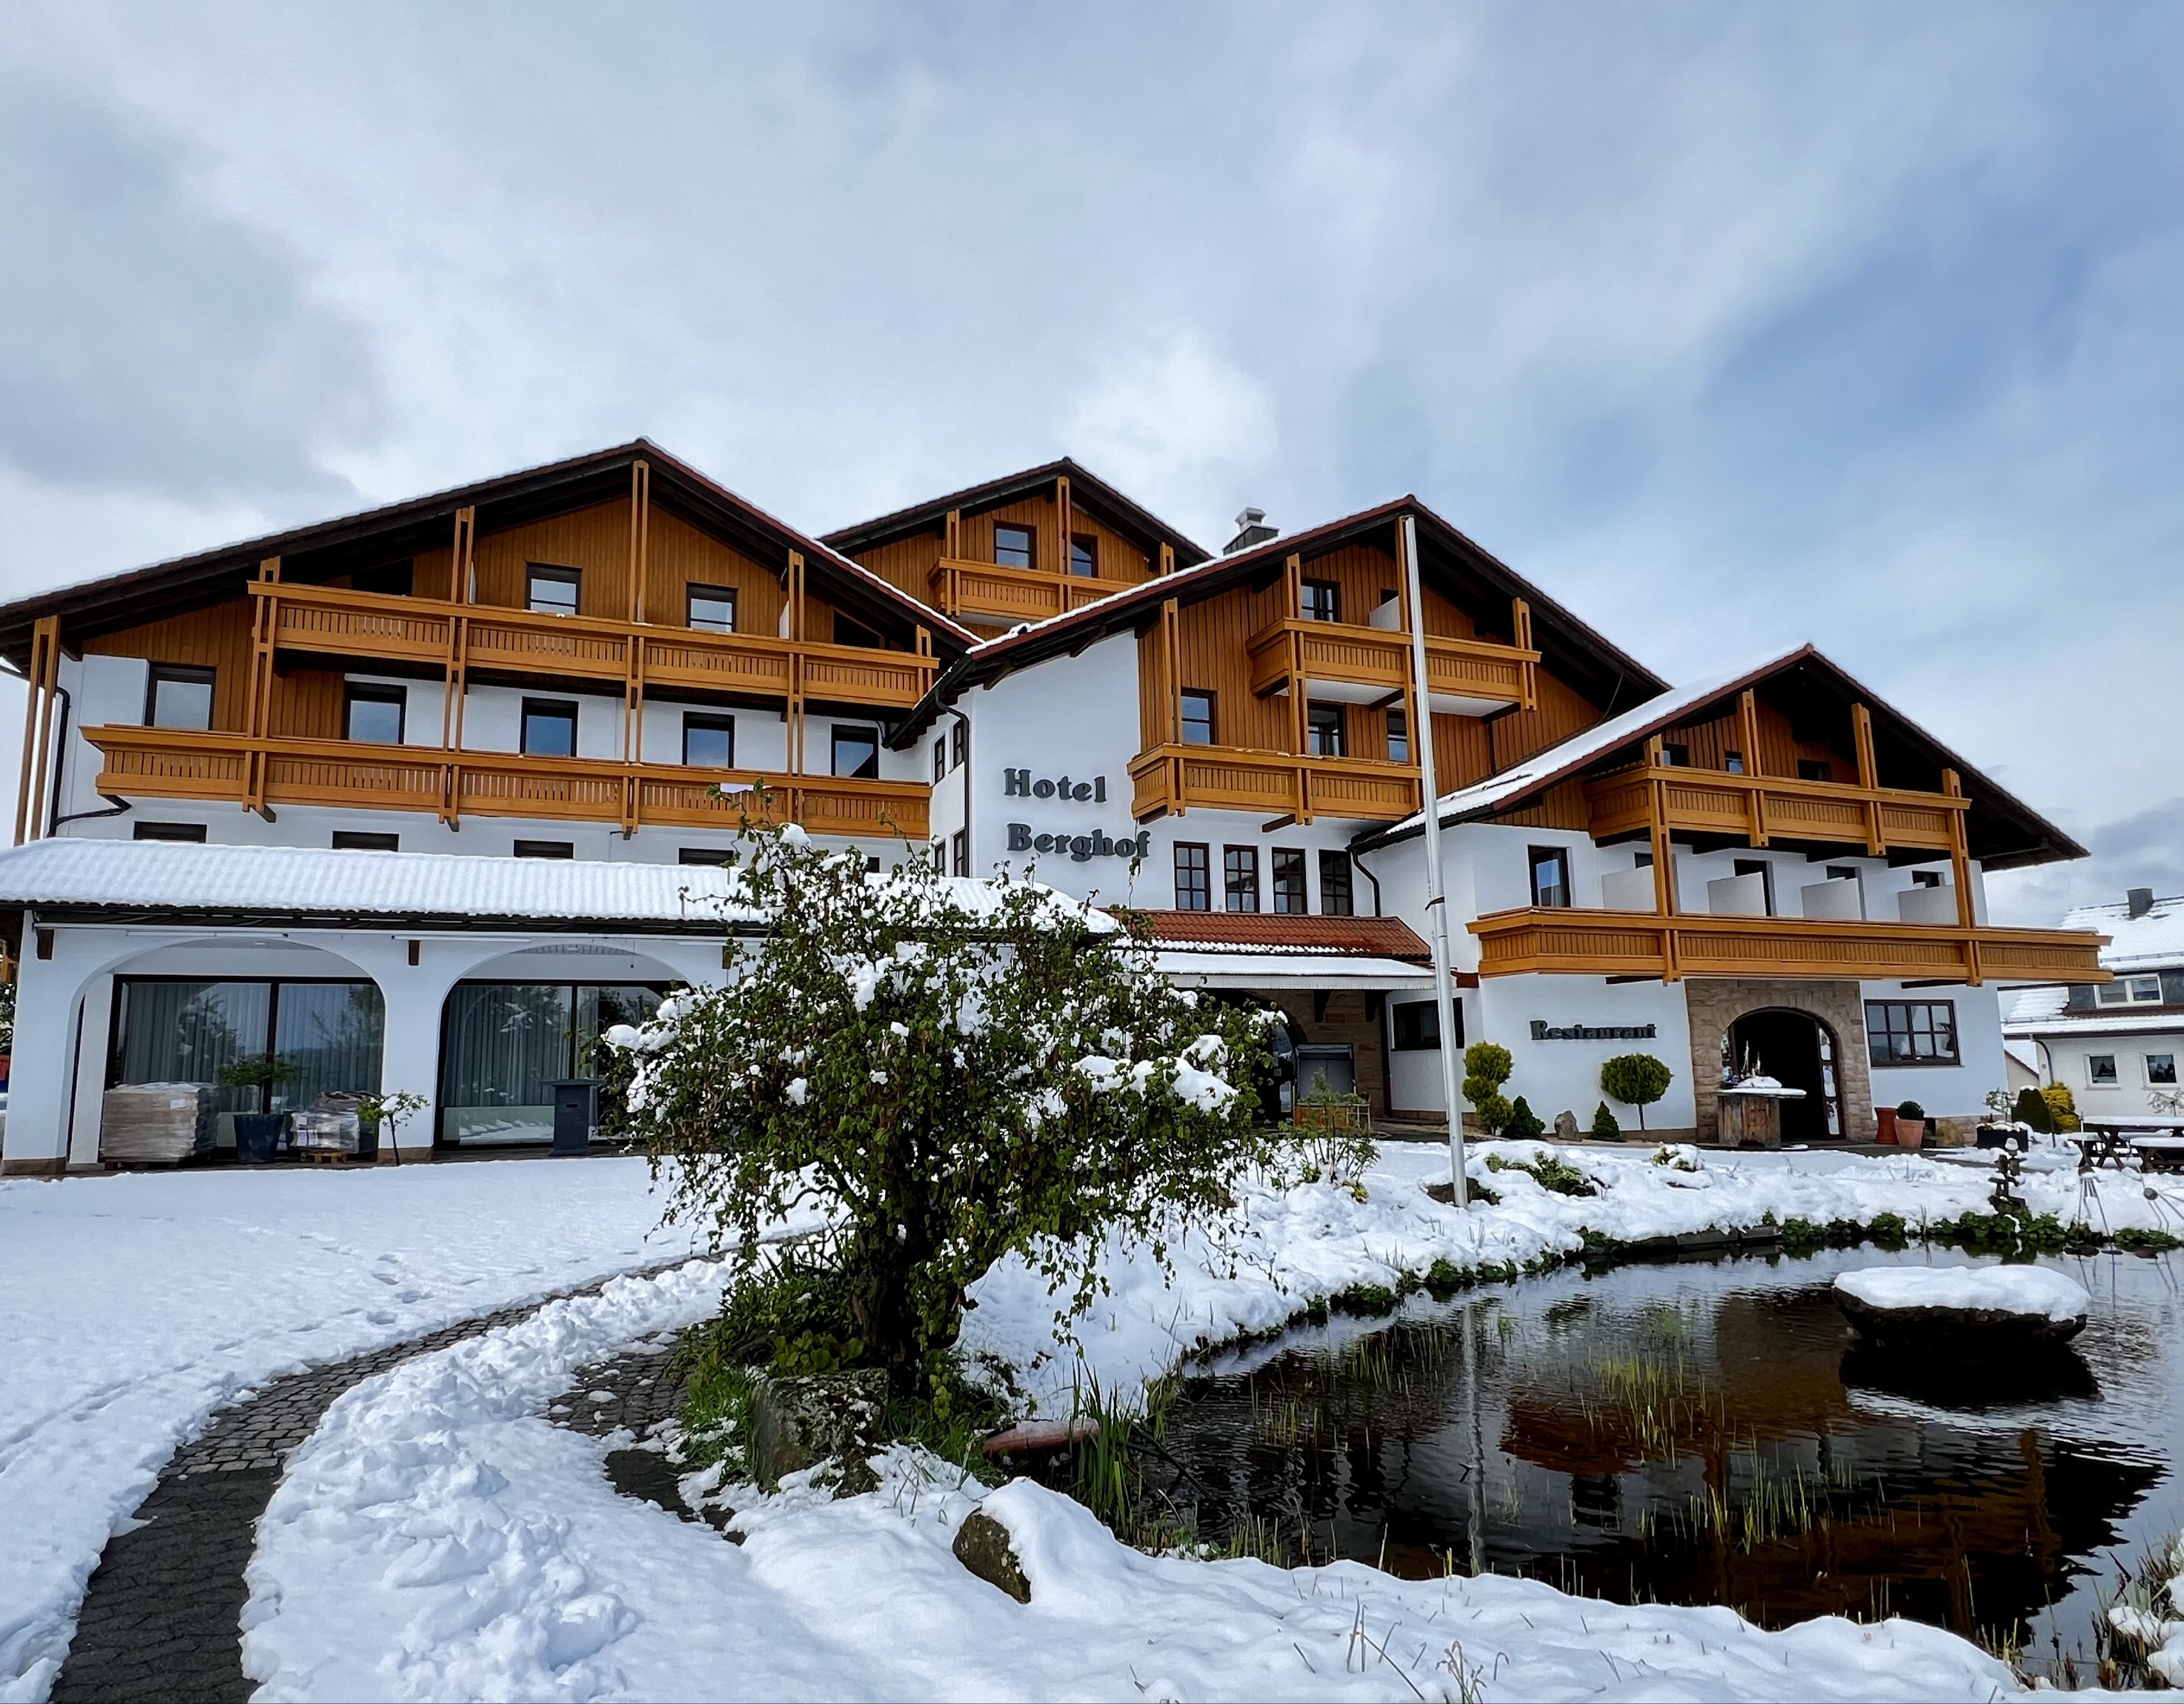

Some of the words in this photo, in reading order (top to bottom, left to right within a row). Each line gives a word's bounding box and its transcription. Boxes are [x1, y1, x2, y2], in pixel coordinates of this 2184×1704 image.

[1004, 767, 1107, 803] Hotel
[1007, 822, 1151, 862] Berghof
[1530, 1020, 1657, 1040] Restaurant
